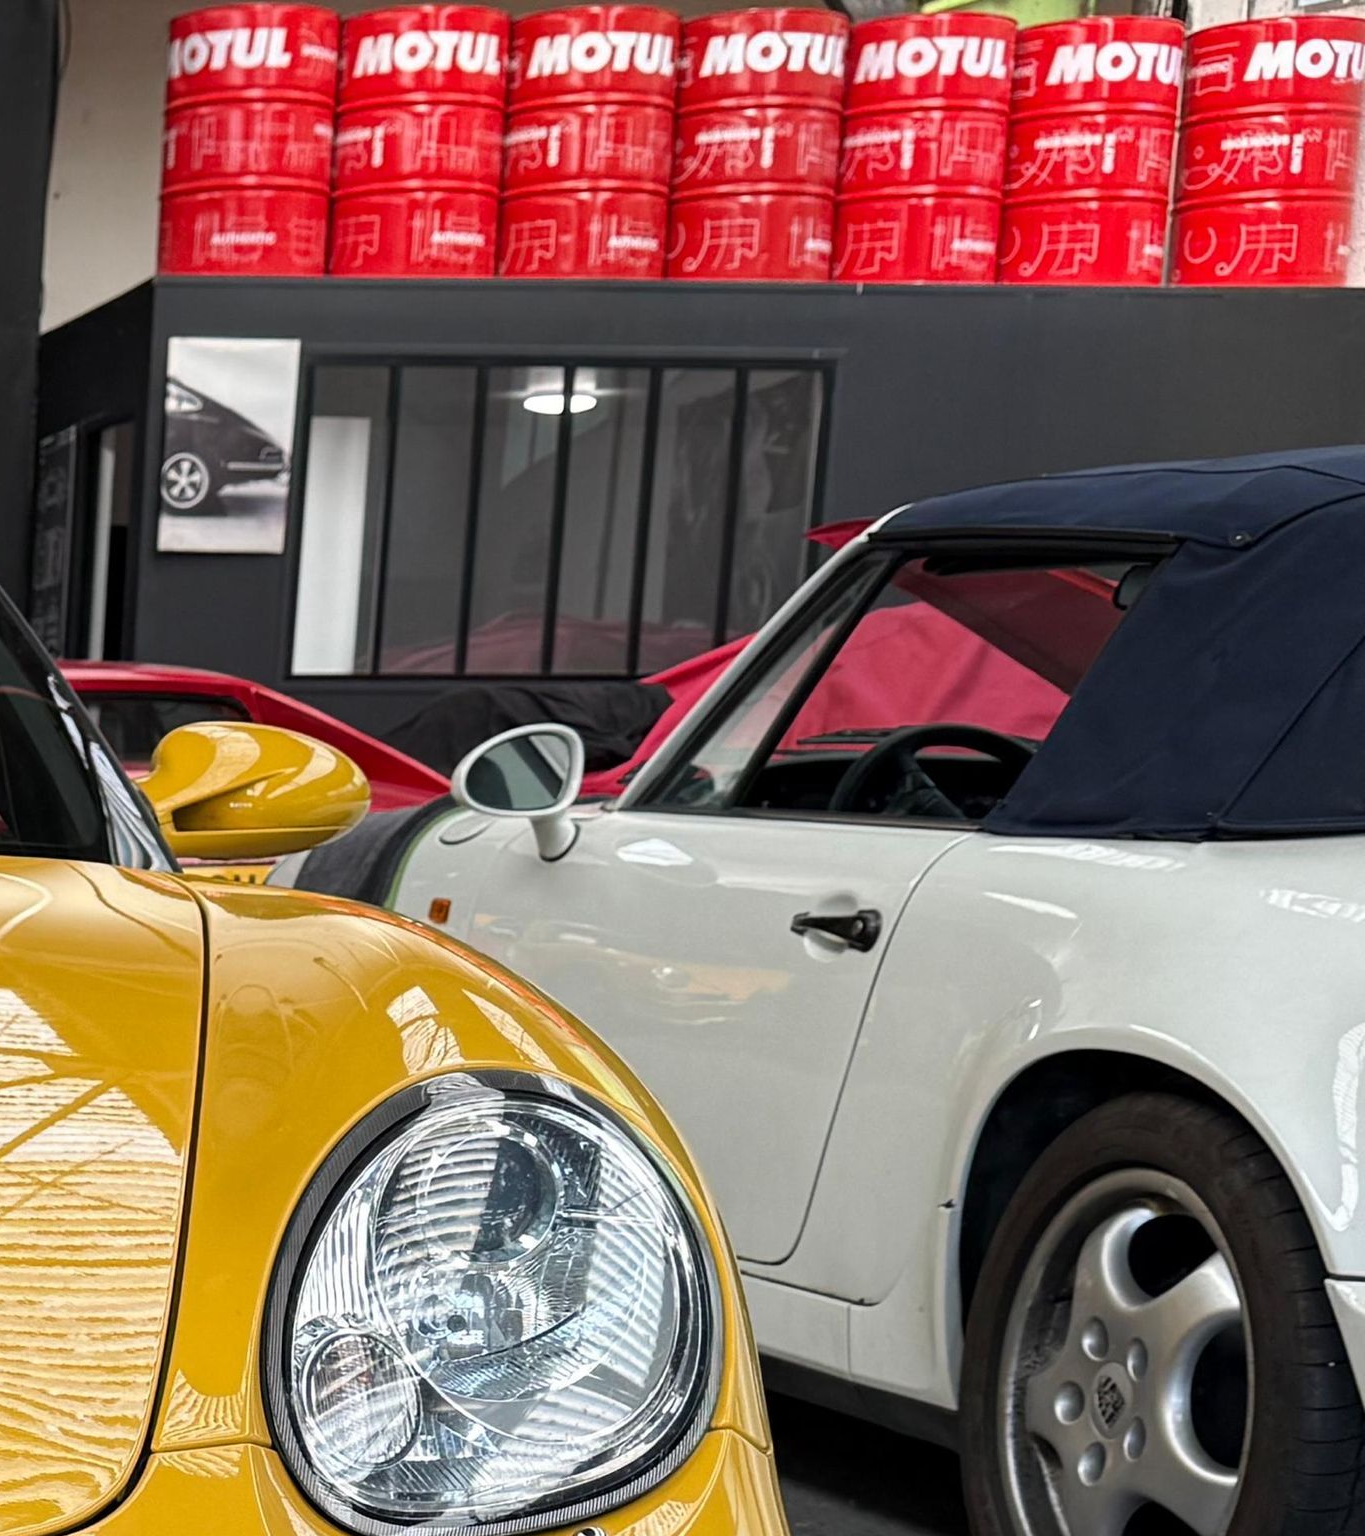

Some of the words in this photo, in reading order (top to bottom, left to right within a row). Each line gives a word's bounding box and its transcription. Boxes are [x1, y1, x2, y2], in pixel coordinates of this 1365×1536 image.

[353, 30, 501, 77] MOTUL
[526, 31, 674, 79] MOTUL
[853, 36, 1008, 84] MOTUL
